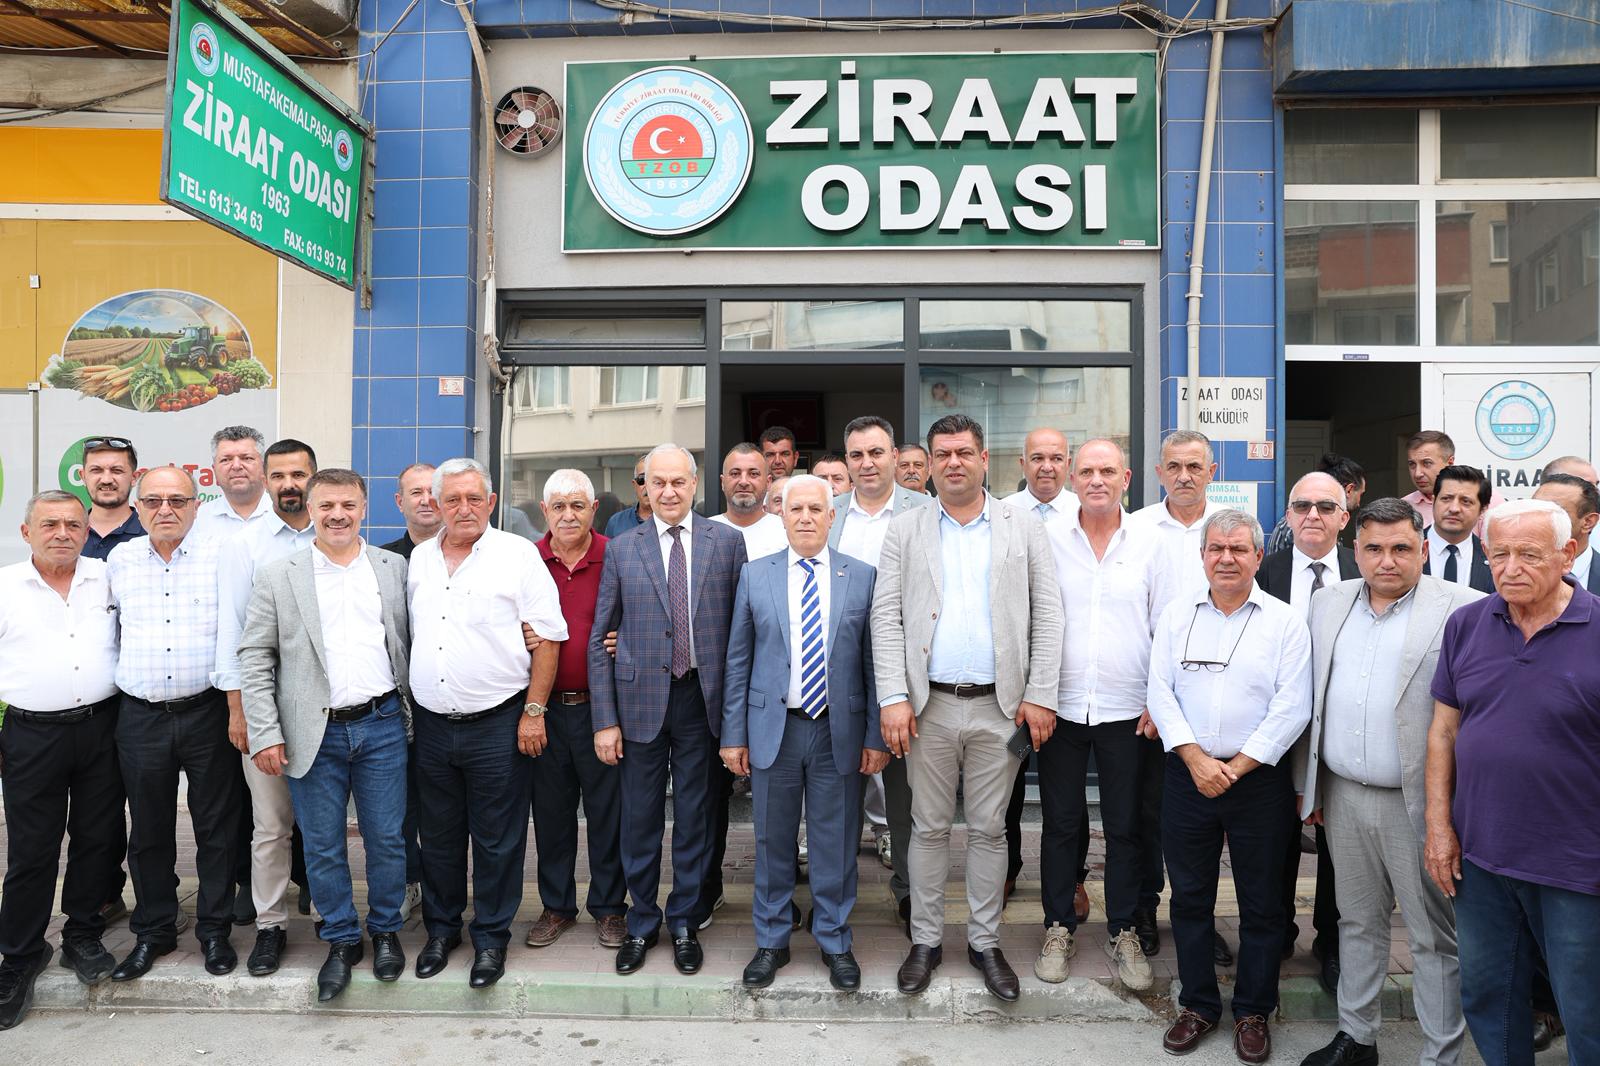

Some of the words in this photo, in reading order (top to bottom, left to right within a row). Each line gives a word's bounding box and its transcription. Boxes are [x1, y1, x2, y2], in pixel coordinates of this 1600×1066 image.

[223, 52, 333, 149] MUSTAFAKEMALPAŞA
[614, 98, 639, 123] TÜRKİYE
[640, 87, 667, 101] ZİRAAT
[668, 87, 702, 102] ODALARI
[766, 60, 1138, 144] ZİRAAT
[183, 78, 284, 180] ZİRAAT
[289, 151, 351, 223] ODASI
[637, 161, 699, 174] TZOB
[179, 172, 206, 204] TEL:
[209, 189, 231, 216] 613
[234, 202, 248, 224] 34
[250, 210, 263, 232] 63
[262, 182, 290, 218] 1963
[644, 179, 690, 190] 1963
[801, 163, 1107, 231] ODASI
[284, 228, 305, 254] FAX:
[306, 240, 322, 262] 613
[324, 250, 335, 268] 93
[336, 256, 347, 274] 74
[1181, 387, 1220, 401] ZAAT
[1231, 387, 1263, 401] ODASI
[1251, 444, 1270, 457] 40
[1486, 464, 1543, 487] İRAA
